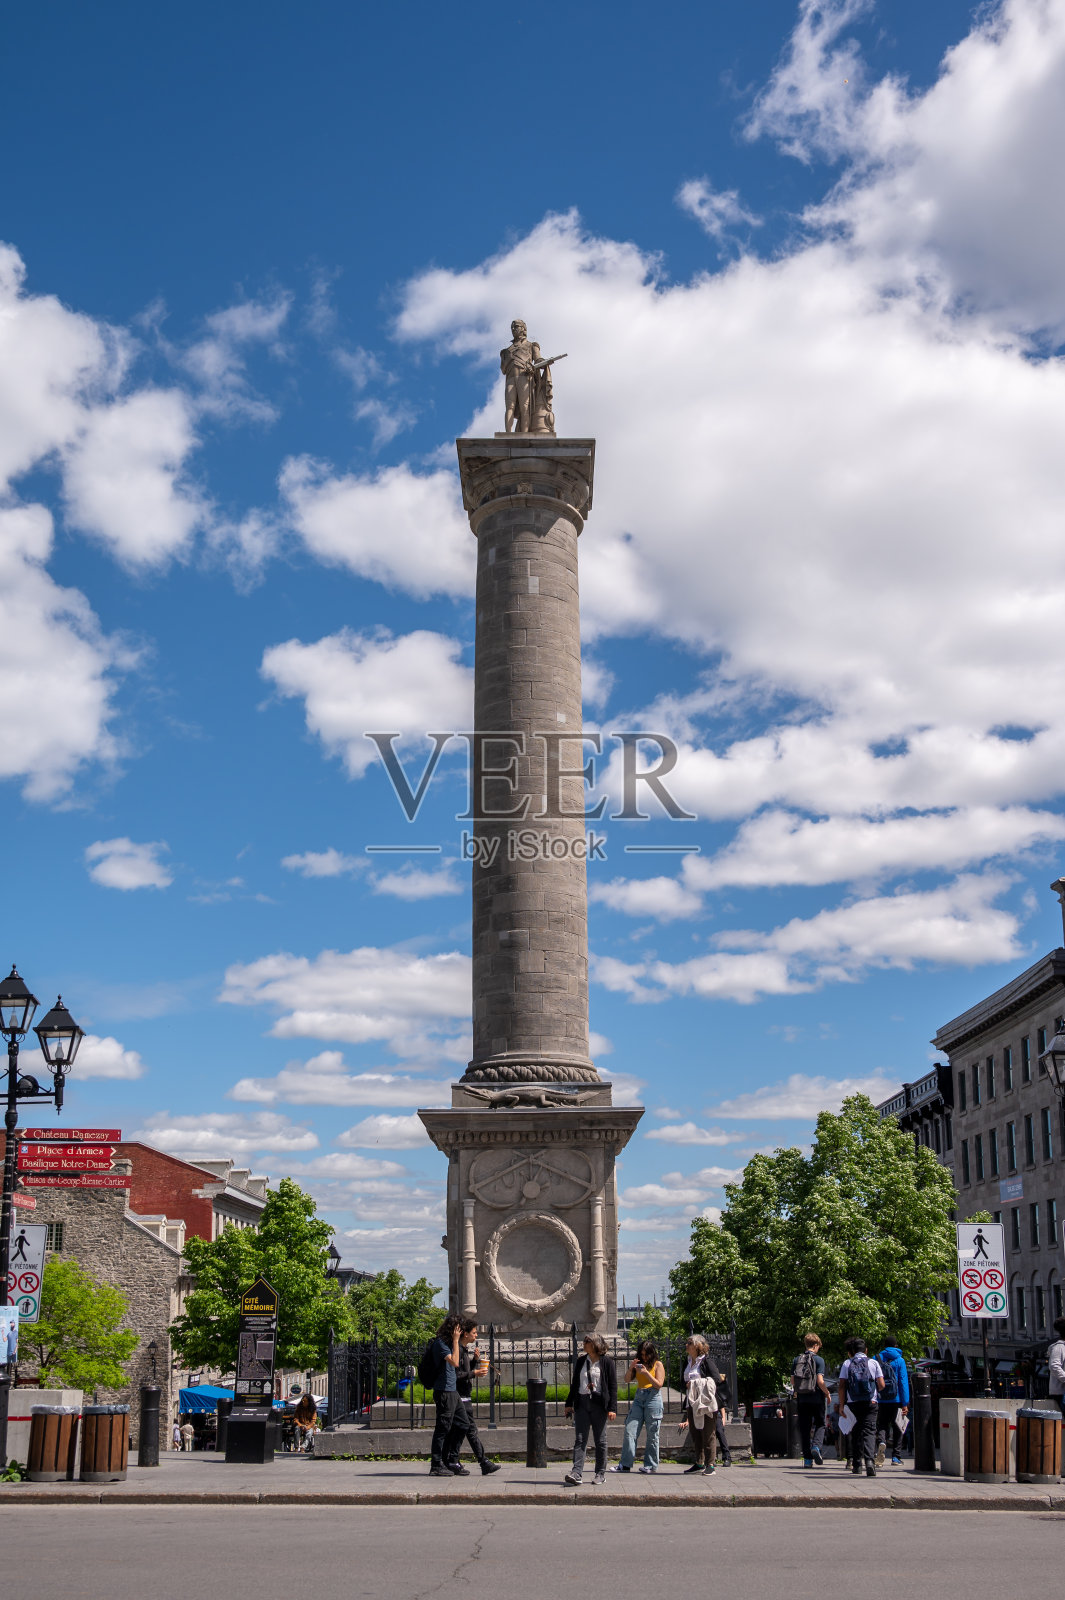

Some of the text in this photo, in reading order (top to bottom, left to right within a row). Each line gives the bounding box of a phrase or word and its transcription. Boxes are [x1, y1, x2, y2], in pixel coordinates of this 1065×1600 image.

[33, 1130, 109, 1141] Château Ramezay
[37, 1145, 104, 1156] Place d'Armes
[22, 1159, 110, 1170] Basilique Notre-Dame
[15, 1262, 38, 1270] PIÉTONNE
